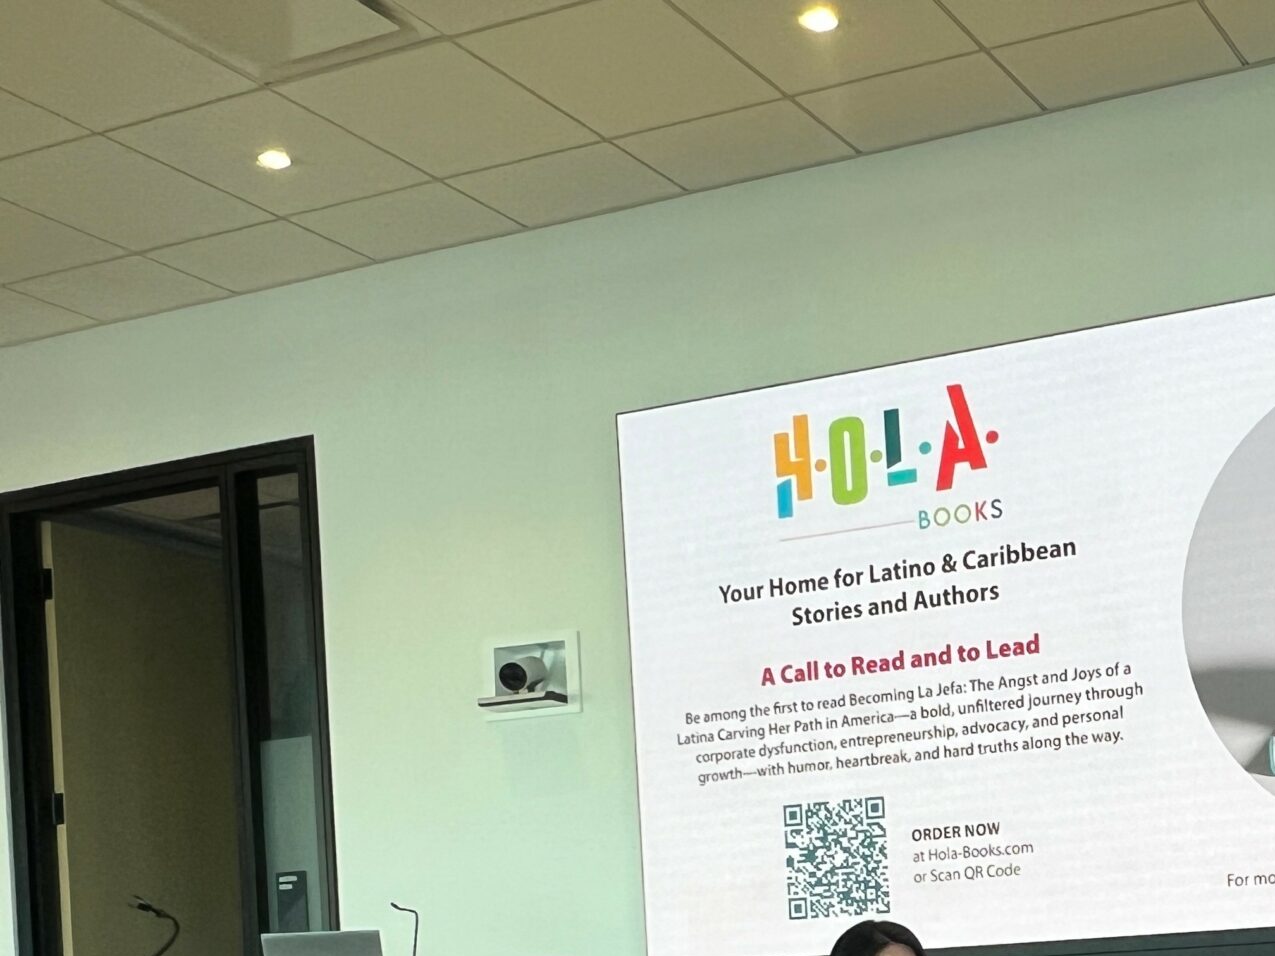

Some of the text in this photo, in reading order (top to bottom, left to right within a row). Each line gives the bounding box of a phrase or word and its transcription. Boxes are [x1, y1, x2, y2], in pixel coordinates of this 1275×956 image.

[919, 499, 1002, 529] BOOKS
[718, 542, 1076, 604] Your Home for Latino & Caribbean
[792, 585, 999, 626] Stories and Authors
[761, 633, 1040, 686] A Call to Read and to Lead
[677, 732, 714, 746] Latina
[718, 726, 765, 741] Carving
[769, 723, 790, 735] Her
[794, 718, 822, 732] Path
[826, 717, 838, 729] in
[920, 703, 954, 718] bold,
[958, 694, 1024, 715] unfiltered
[1028, 692, 1082, 711] journey
[1085, 682, 1143, 700] through
[686, 662, 1131, 727] Be among the first to read Becoming La Jefa: The Angst and Joys of a
[696, 705, 1123, 764] corporate dysfunction, entrepreneurship, advocacy, and personal
[788, 761, 832, 774] humor,
[836, 750, 911, 768] heartbreak,
[914, 746, 940, 761] and
[944, 742, 974, 758] hard
[978, 739, 1018, 755] truths
[1022, 737, 1061, 750] along
[1065, 732, 1088, 746] the
[1092, 731, 1124, 744] way.
[912, 822, 1000, 842] ORDER NOW
[913, 844, 1034, 863] at Hola-Books.com
[914, 863, 1021, 883] or Scan QR Code
[1227, 874, 1249, 887] For
